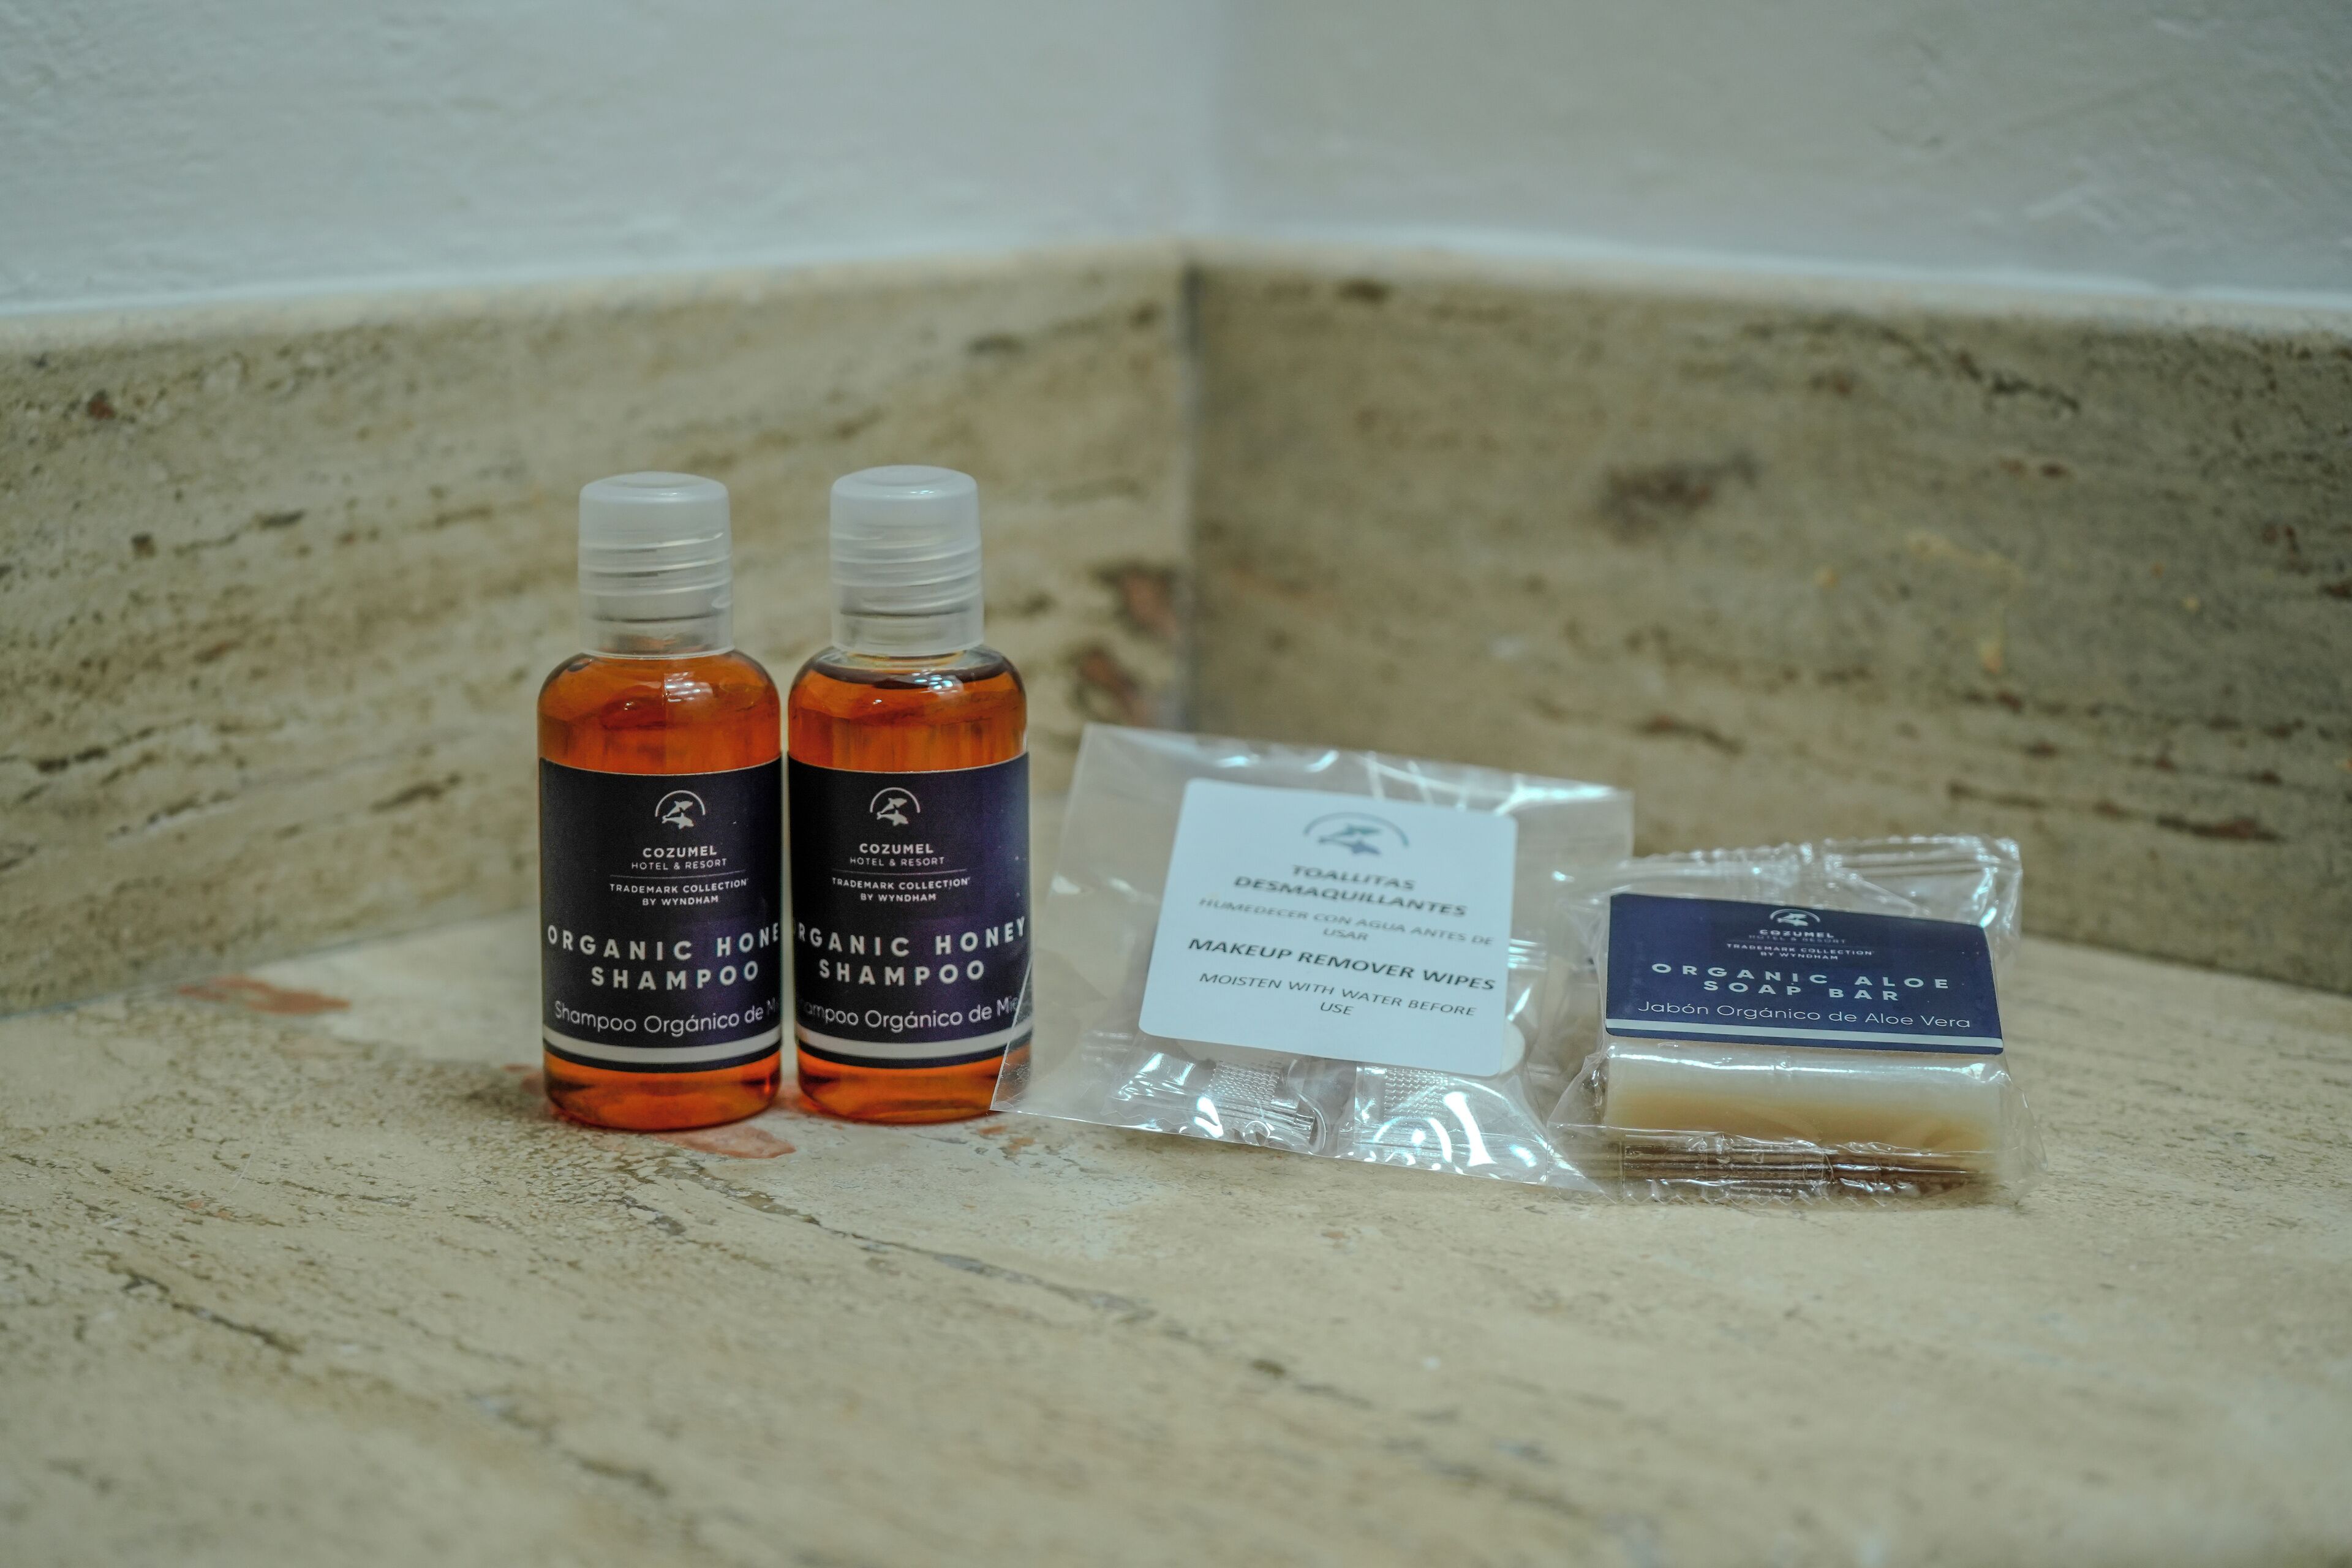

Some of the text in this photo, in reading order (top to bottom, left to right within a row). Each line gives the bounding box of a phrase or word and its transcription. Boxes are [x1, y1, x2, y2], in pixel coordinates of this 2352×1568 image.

[643, 845, 717, 858] COZUMEL
[859, 843, 934, 854] COZUMEL
[631, 862, 668, 870] HOTEL
[685, 858, 727, 870] RESORT
[850, 857, 884, 866] HOTEL
[901, 856, 944, 866] RESORT
[610, 883, 678, 894] TRADEMARK
[832, 877, 894, 889] TRADEMARK
[1292, 865, 1415, 890] TOALLITAS
[662, 895, 718, 906] WYNDHAM
[878, 893, 937, 902] WYNDHAM
[1234, 876, 1468, 916] DESMAQUILLANTES
[1199, 897, 1494, 945] HUMEDECER CON AGUA ANTES DE
[548, 922, 778, 960] ORGANIC HONE
[799, 916, 1025, 957] RGANIC HONEY
[1323, 928, 1368, 940] USAR
[1760, 929, 1834, 939] COZUMEL
[1727, 943, 1795, 952] TRADEMARK
[591, 960, 758, 990] SHAMPOO
[819, 959, 985, 987] SHAMPOO
[1188, 938, 1495, 990] MAKEUP REMOVER WIPES
[1652, 963, 1948, 989] ORGANIC ALOE
[1199, 973, 1477, 1016] MOISTEN WITH WATER BEFORE
[1703, 980, 1898, 1001] SOAP BAR
[554, 1000, 636, 1032] Shampoo
[644, 1009, 739, 1037] Orgánico
[744, 1005, 764, 1023] de
[865, 1008, 962, 1033] Orgánico
[968, 1005, 992, 1023] de
[1321, 1001, 1354, 1015] USE
[1638, 1001, 1970, 1028] Jabón Orgánico de Aloe Vera
